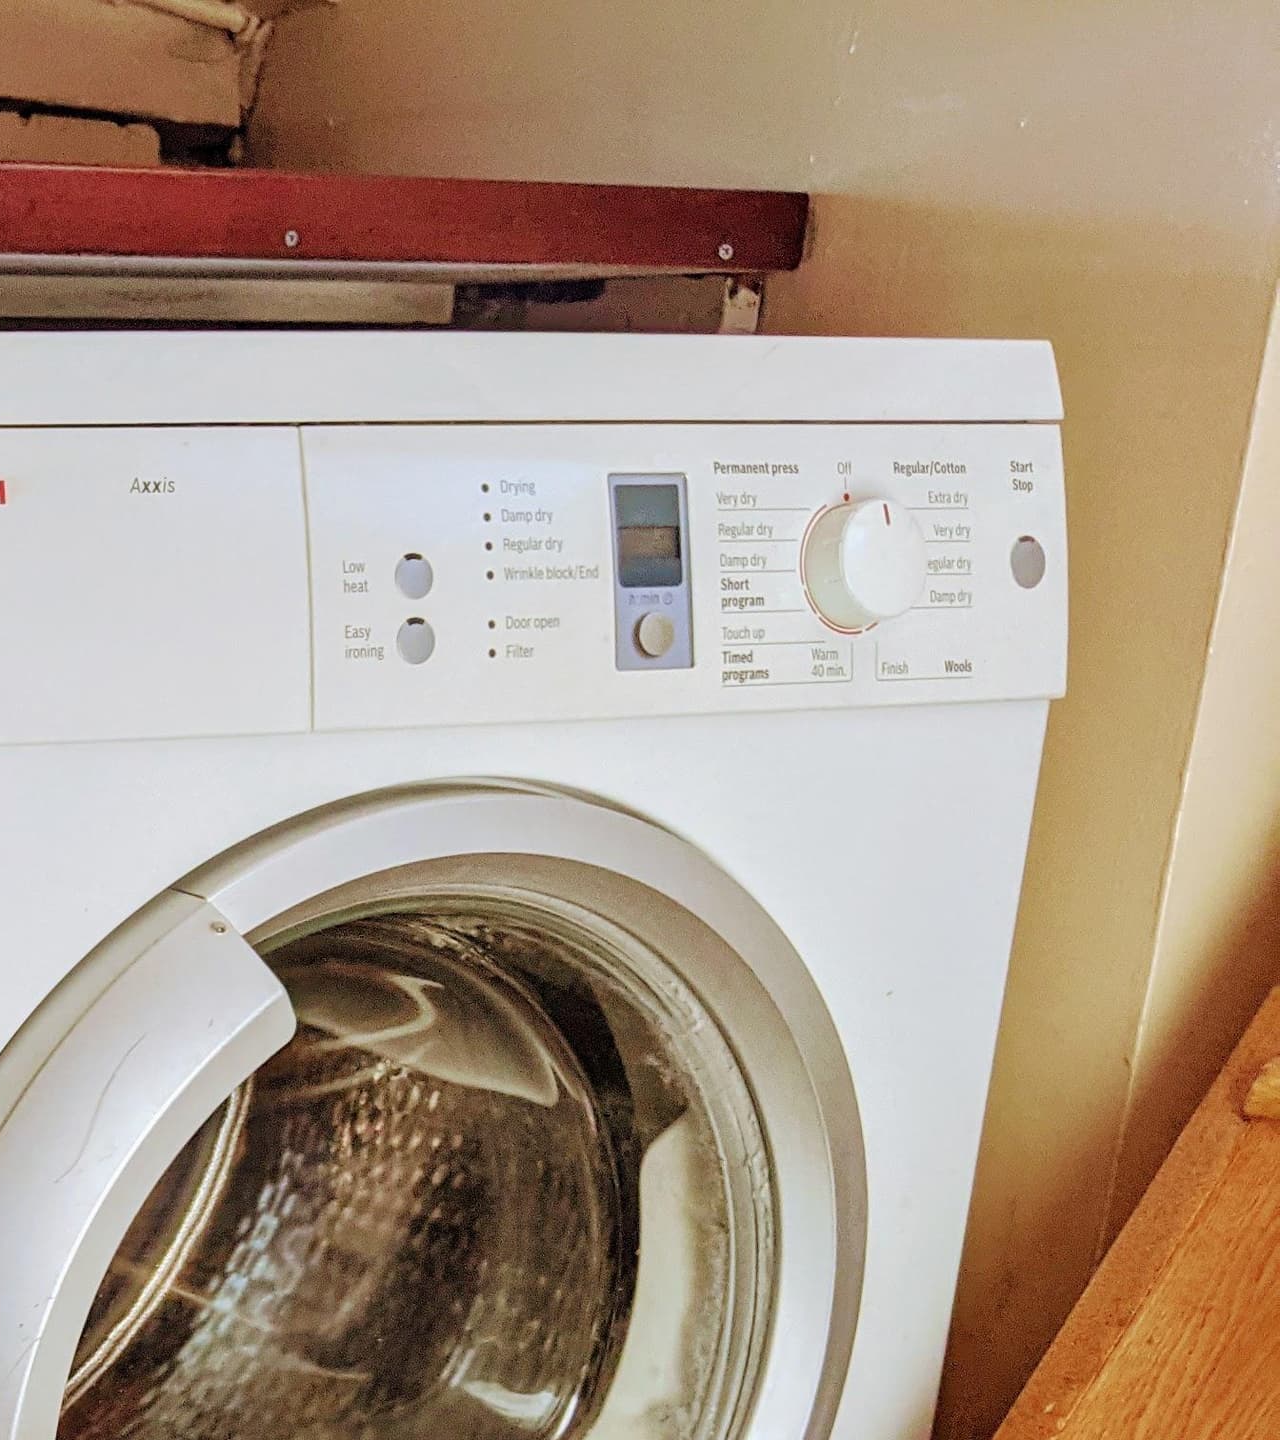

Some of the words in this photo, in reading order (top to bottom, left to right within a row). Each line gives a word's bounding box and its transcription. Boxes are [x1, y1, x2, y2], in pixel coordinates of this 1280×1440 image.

[714, 462, 769, 474] Permanent
[772, 463, 798, 476] press
[837, 463, 851, 474] Off
[893, 462, 966, 477] Regular/Cotton
[1010, 461, 1033, 473] Start
[130, 477, 175, 494] Axxis
[500, 480, 535, 496] Drying
[1012, 479, 1033, 492] Stop
[717, 492, 738, 507] Very
[741, 492, 757, 507] dry
[928, 492, 950, 504] Extra
[953, 491, 968, 505] dry
[501, 510, 532, 524] Damp
[535, 509, 553, 524] dry
[718, 523, 755, 538] Regular
[758, 522, 773, 538] dry
[934, 524, 954, 538] Very
[956, 523, 971, 537] dry
[503, 539, 542, 554] Regular
[545, 538, 563, 553] dry
[342, 561, 365, 574] Low
[720, 554, 749, 569] Damp
[752, 553, 767, 568] dry
[928, 558, 954, 572] egular
[957, 556, 971, 570] dry
[504, 567, 543, 580] Wrinkle
[343, 580, 368, 593] heat
[721, 579, 749, 591] Short
[721, 596, 764, 609] program
[930, 590, 956, 604] Damp
[958, 589, 972, 603] dry
[505, 616, 532, 629] Door
[535, 617, 560, 631] open
[345, 625, 371, 640] Easy
[722, 627, 750, 639] Touch
[752, 629, 765, 641] up
[345, 646, 384, 661] ironing
[506, 645, 534, 657] Filter
[723, 651, 752, 664] Timed
[812, 649, 838, 661] Warm
[811, 666, 824, 677] 40
[827, 666, 847, 676] min.
[882, 661, 909, 675] Finish
[945, 660, 972, 673] Wools
[722, 670, 769, 683] programs
